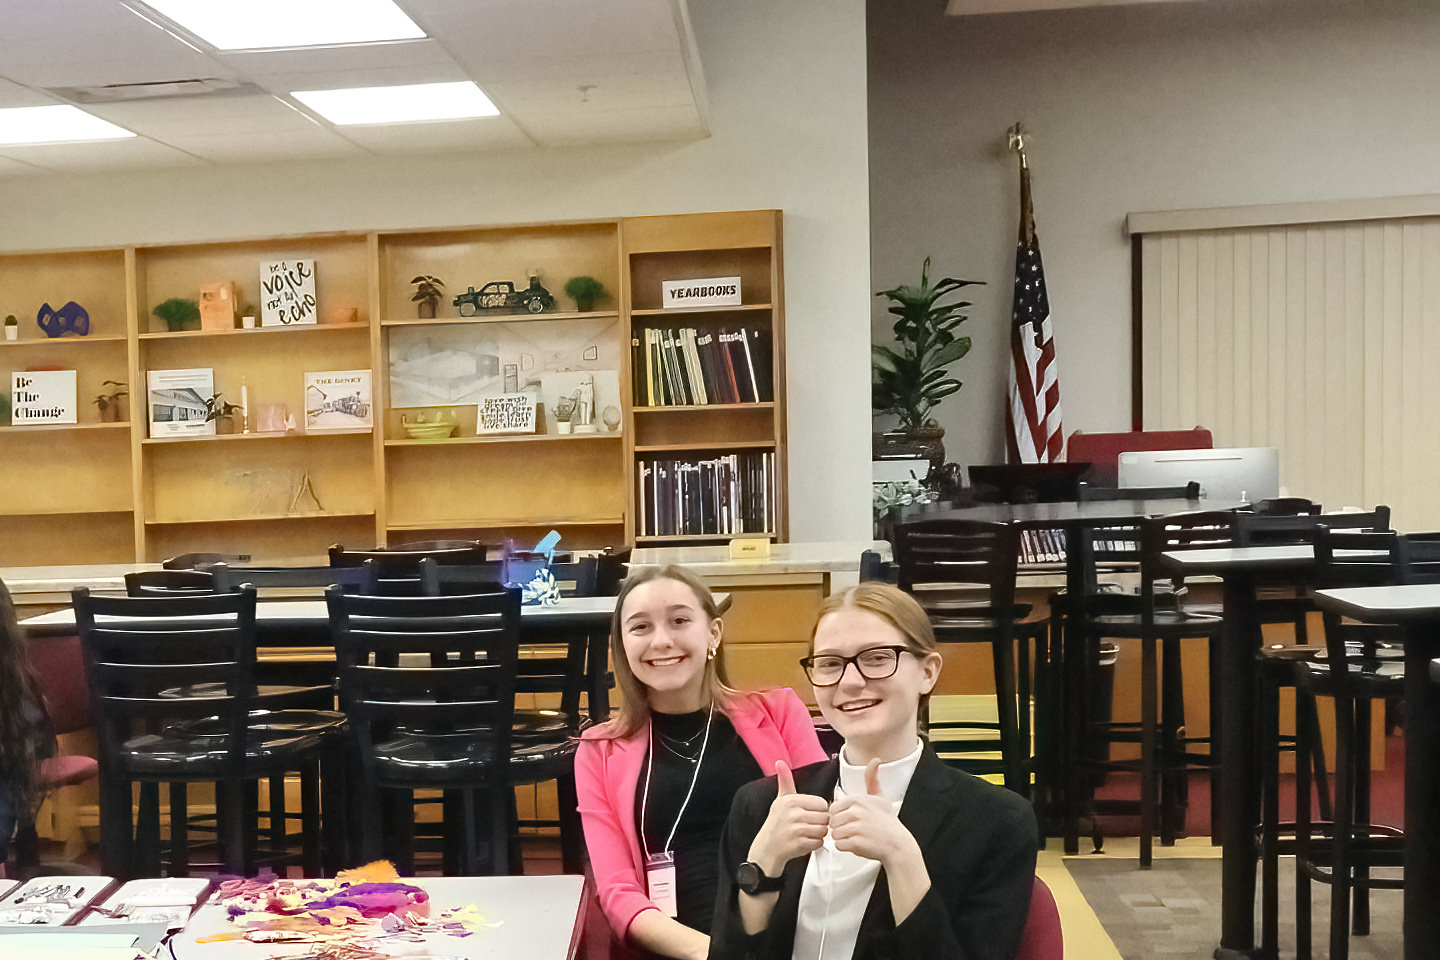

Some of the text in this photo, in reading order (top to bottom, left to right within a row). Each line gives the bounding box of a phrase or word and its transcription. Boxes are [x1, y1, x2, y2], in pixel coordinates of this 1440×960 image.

[263, 262, 311, 298] voice
[670, 285, 737, 299] YEARBOOKS
[279, 294, 316, 324] echo
[16, 377, 33, 388] Be
[14, 391, 40, 402] The
[15, 406, 65, 418] Change
